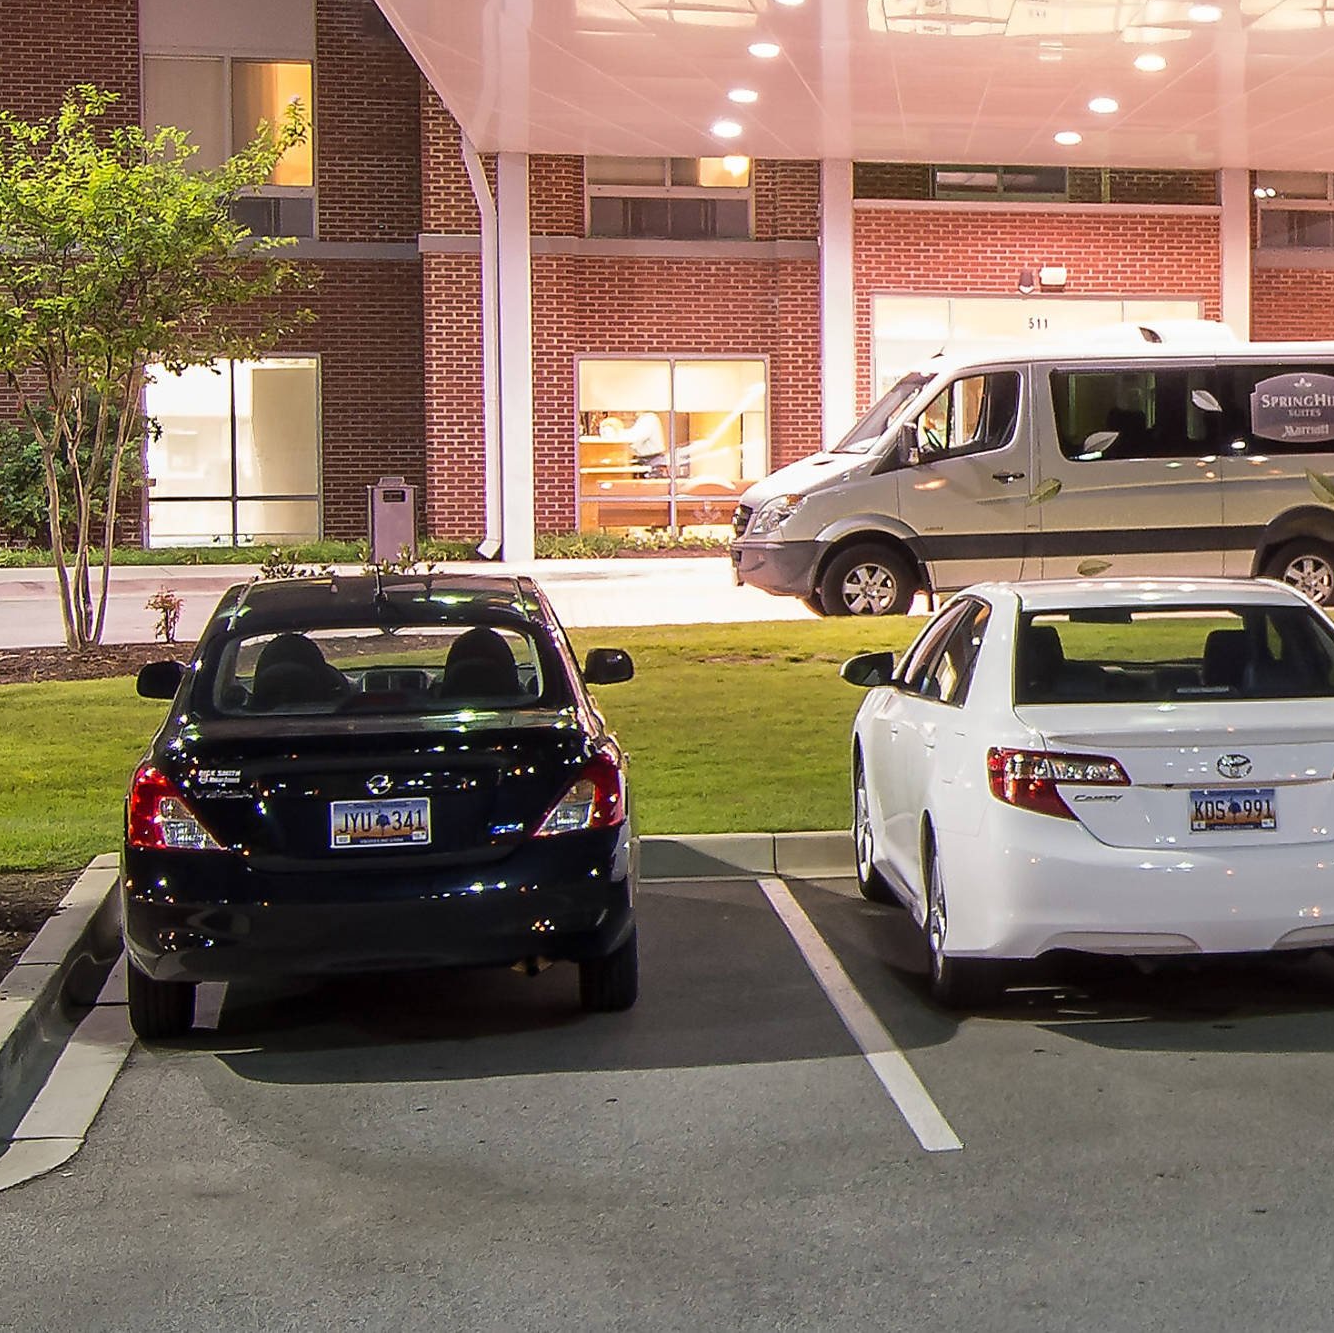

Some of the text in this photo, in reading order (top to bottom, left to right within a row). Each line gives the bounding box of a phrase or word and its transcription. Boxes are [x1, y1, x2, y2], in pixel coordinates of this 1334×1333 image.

[1027, 316, 1048, 330] 511
[1288, 408, 1322, 418] SUITES
[1281, 424, 1330, 438] Marriott
[1194, 798, 1273, 821] KDS 991
[339, 808, 427, 834] JYU 341
